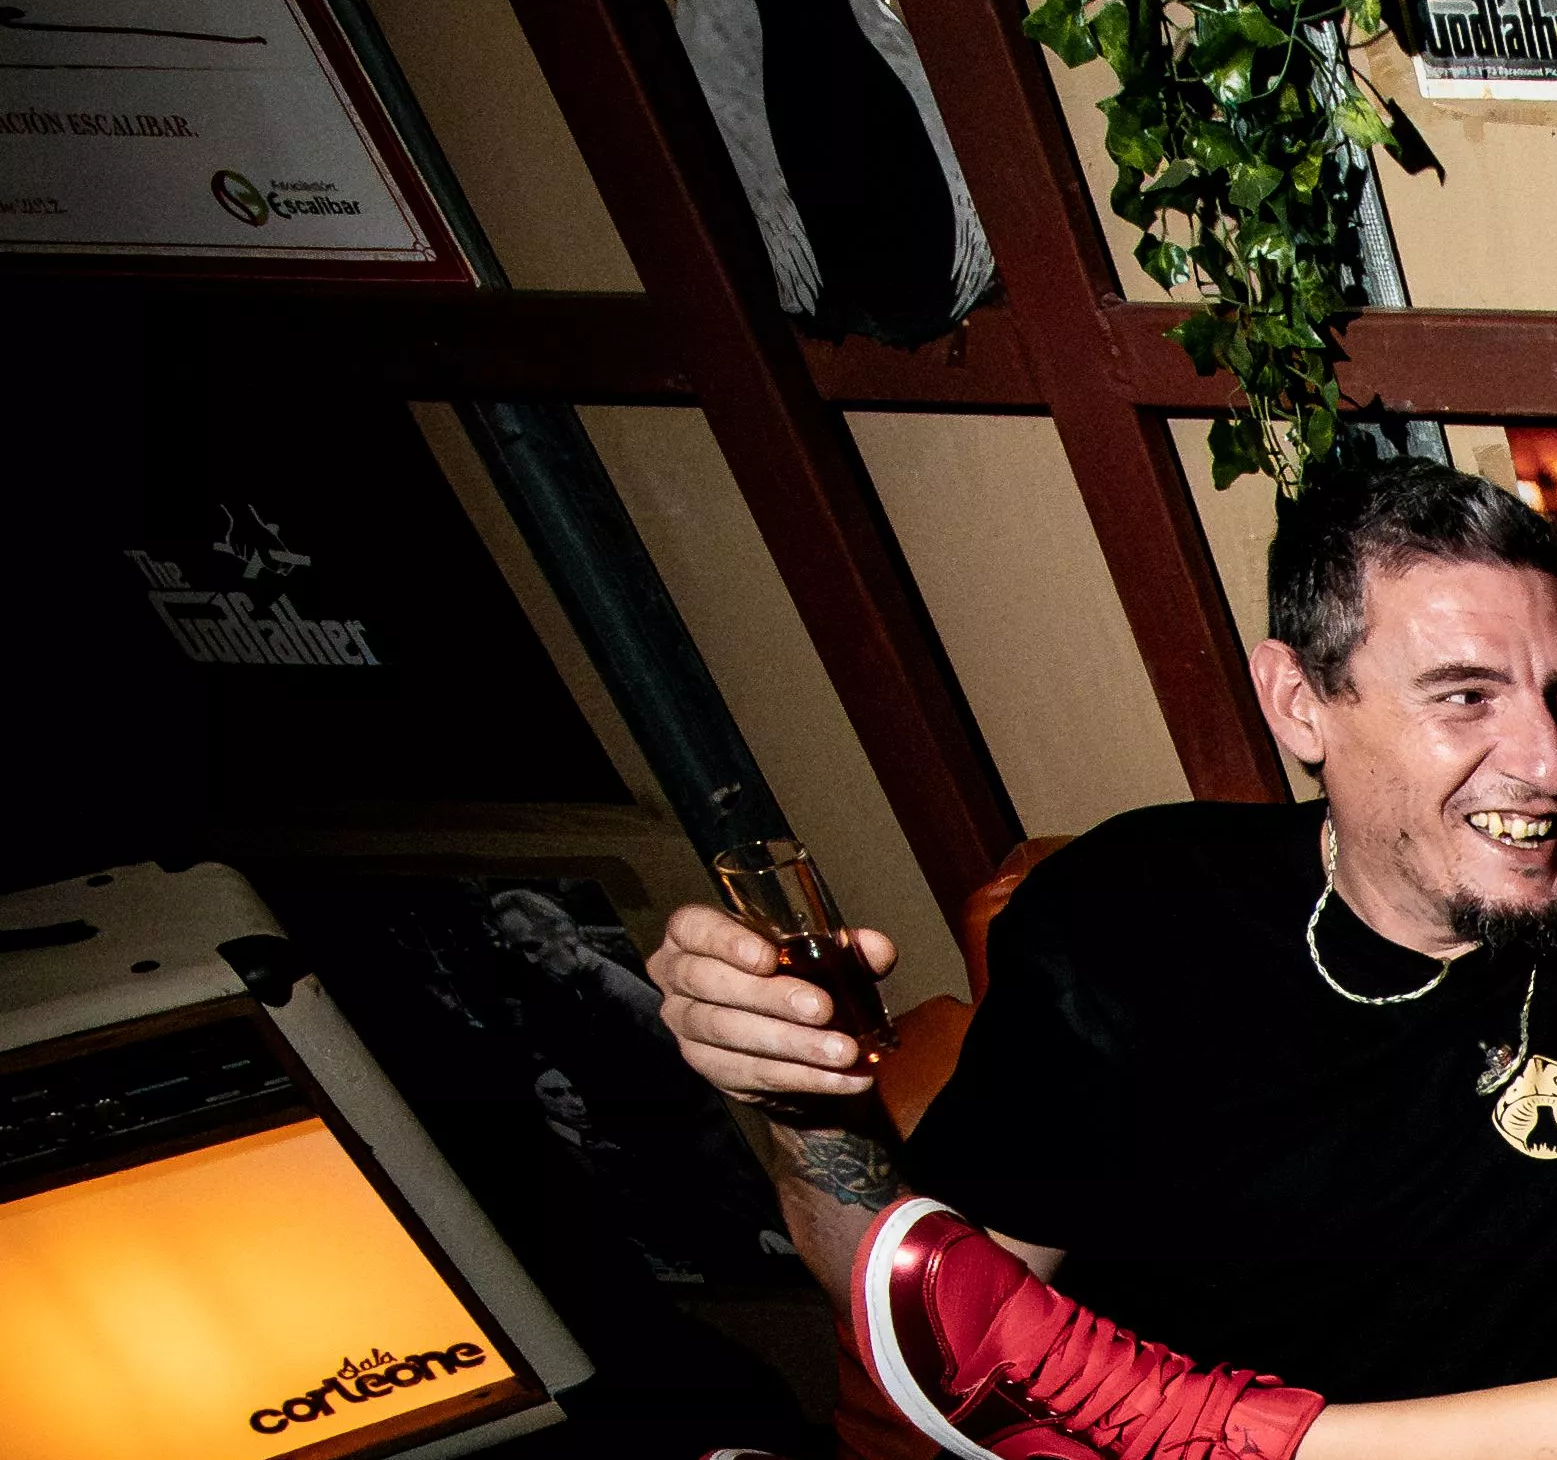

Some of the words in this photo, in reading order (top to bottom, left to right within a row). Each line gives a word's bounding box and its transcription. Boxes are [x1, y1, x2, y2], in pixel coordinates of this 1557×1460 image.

[67, 113, 200, 139] ESCALIBAR.
[267, 191, 362, 220] Escalibar
[124, 549, 191, 590] The
[148, 590, 383, 670] Godfather
[250, 1342, 486, 1434] corleone
